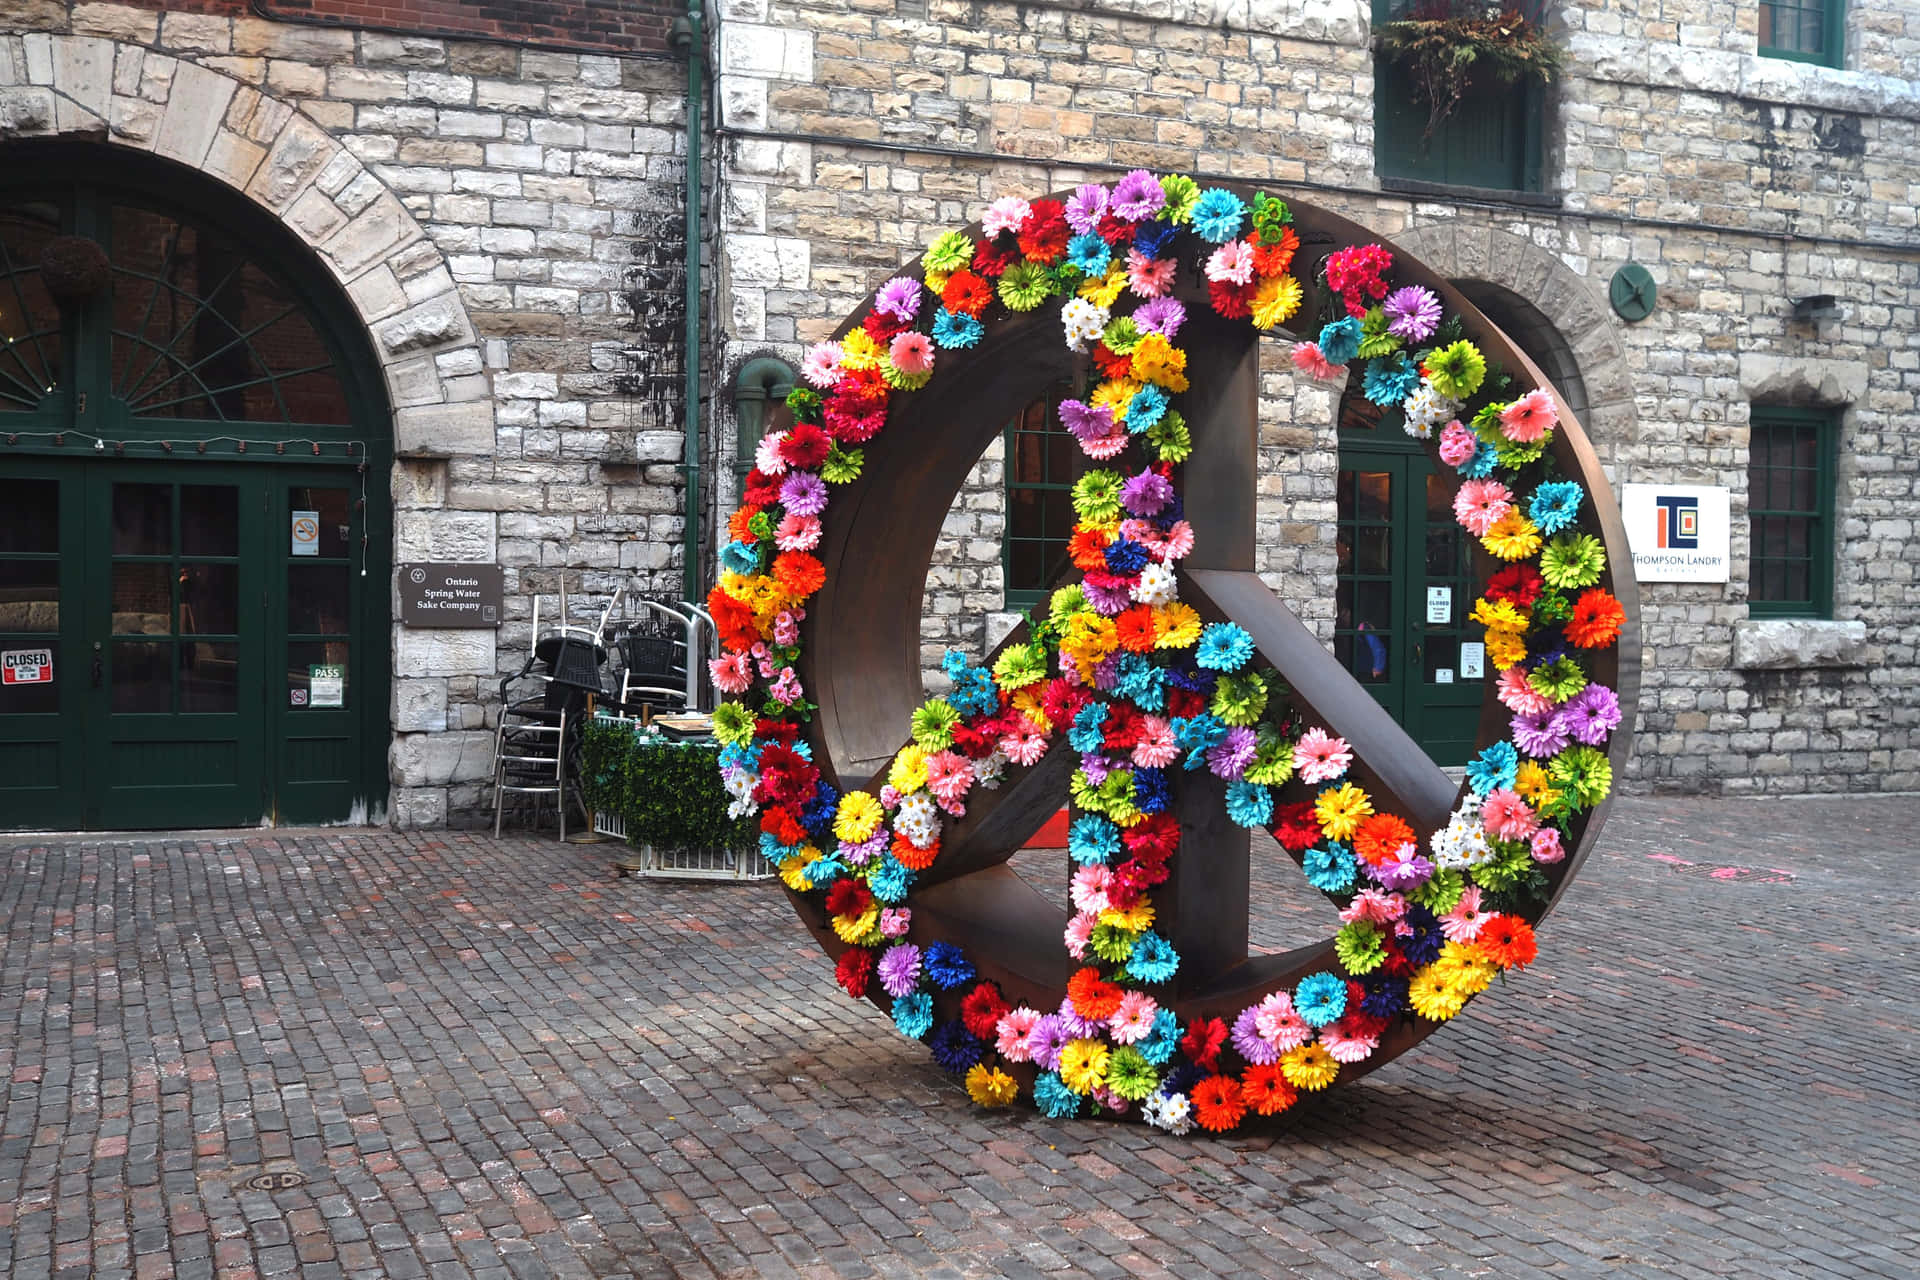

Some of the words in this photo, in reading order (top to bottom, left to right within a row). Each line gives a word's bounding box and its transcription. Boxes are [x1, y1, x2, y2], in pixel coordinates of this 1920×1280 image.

[1632, 552, 1684, 565] THOMPSON
[1687, 553, 1721, 566] LANDRY
[445, 578, 478, 586] Ontario
[424, 589, 454, 599] Spring
[455, 589, 480, 598] Water
[417, 601, 438, 609] Sake
[440, 601, 480, 611] Company
[6, 654, 47, 667] CLOSED
[315, 669, 339, 678] PASS
